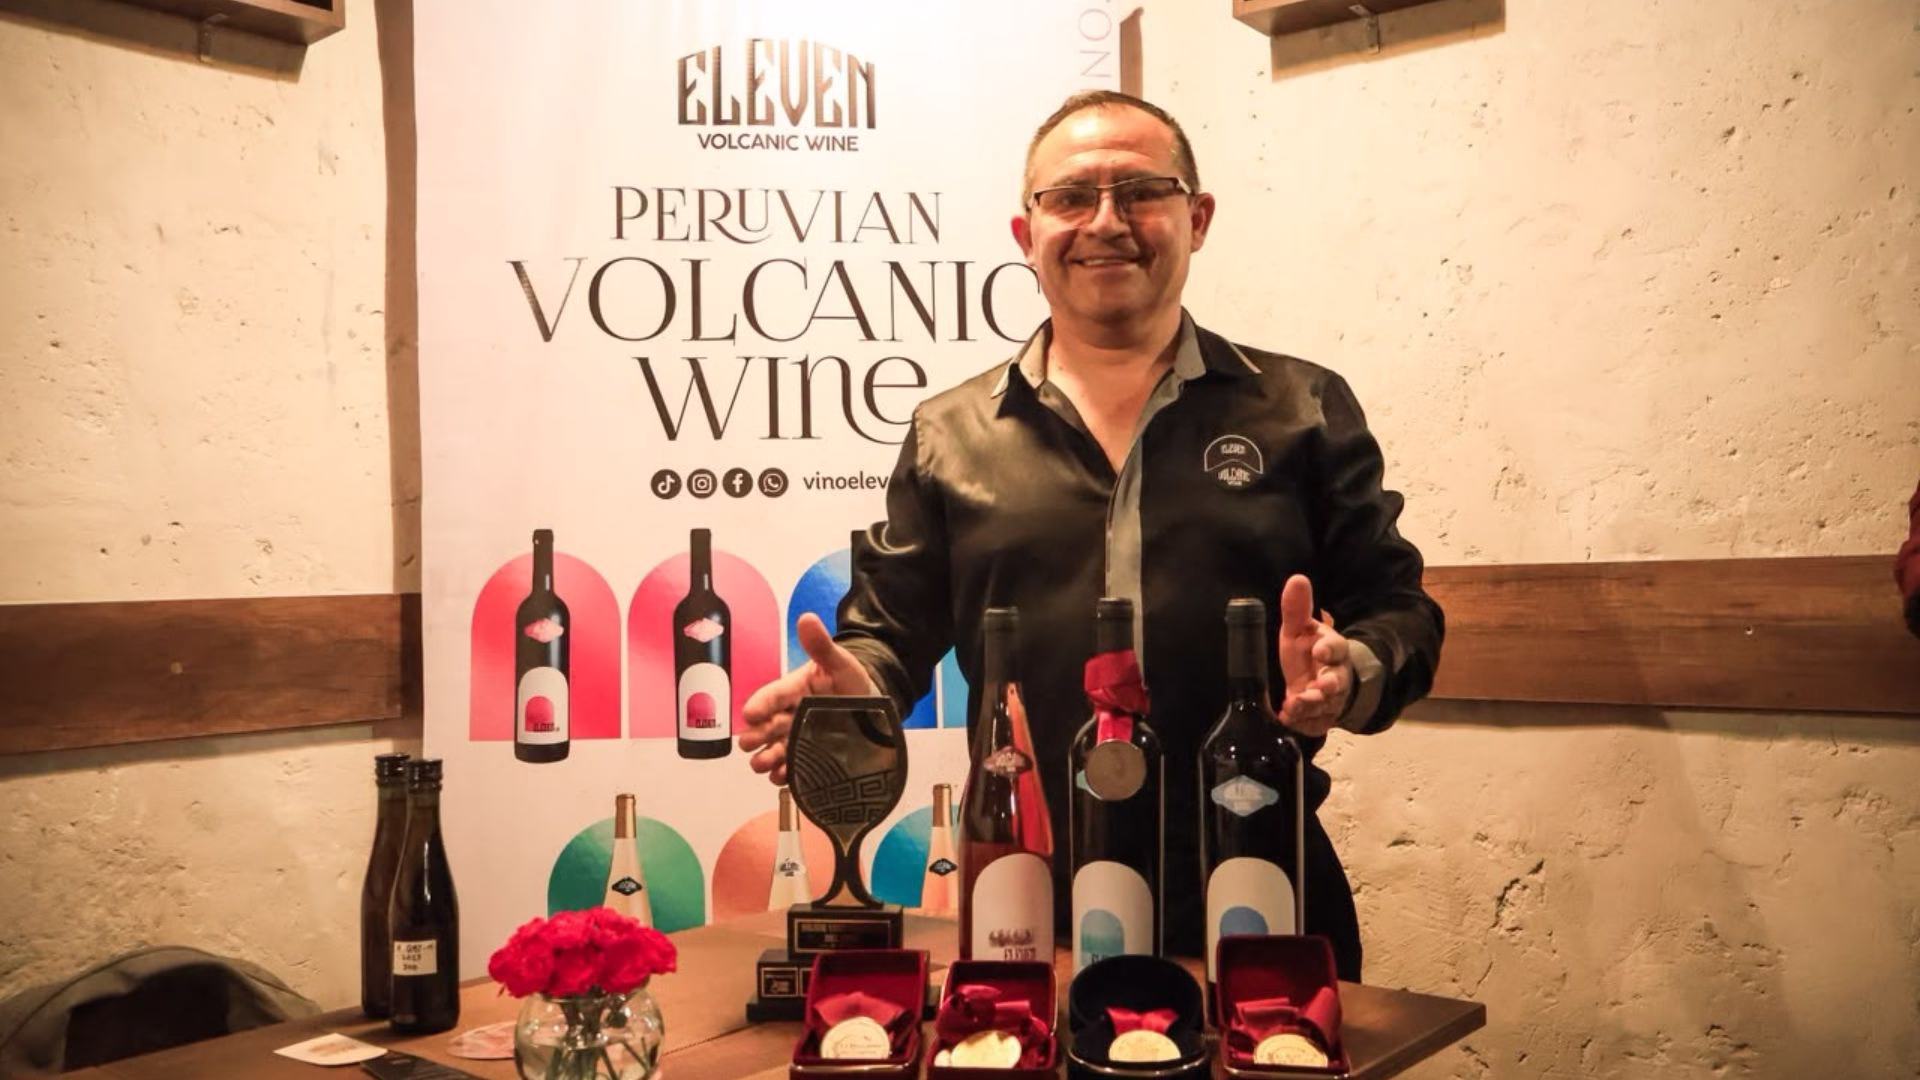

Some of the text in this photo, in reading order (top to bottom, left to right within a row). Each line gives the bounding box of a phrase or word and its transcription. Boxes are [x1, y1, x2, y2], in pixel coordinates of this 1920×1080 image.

[677, 37, 876, 129] ELEVEN
[697, 132, 860, 152] VOLCANIC WINE
[609, 185, 943, 245] PERUVIAN
[506, 256, 1041, 346] VOLCANIC
